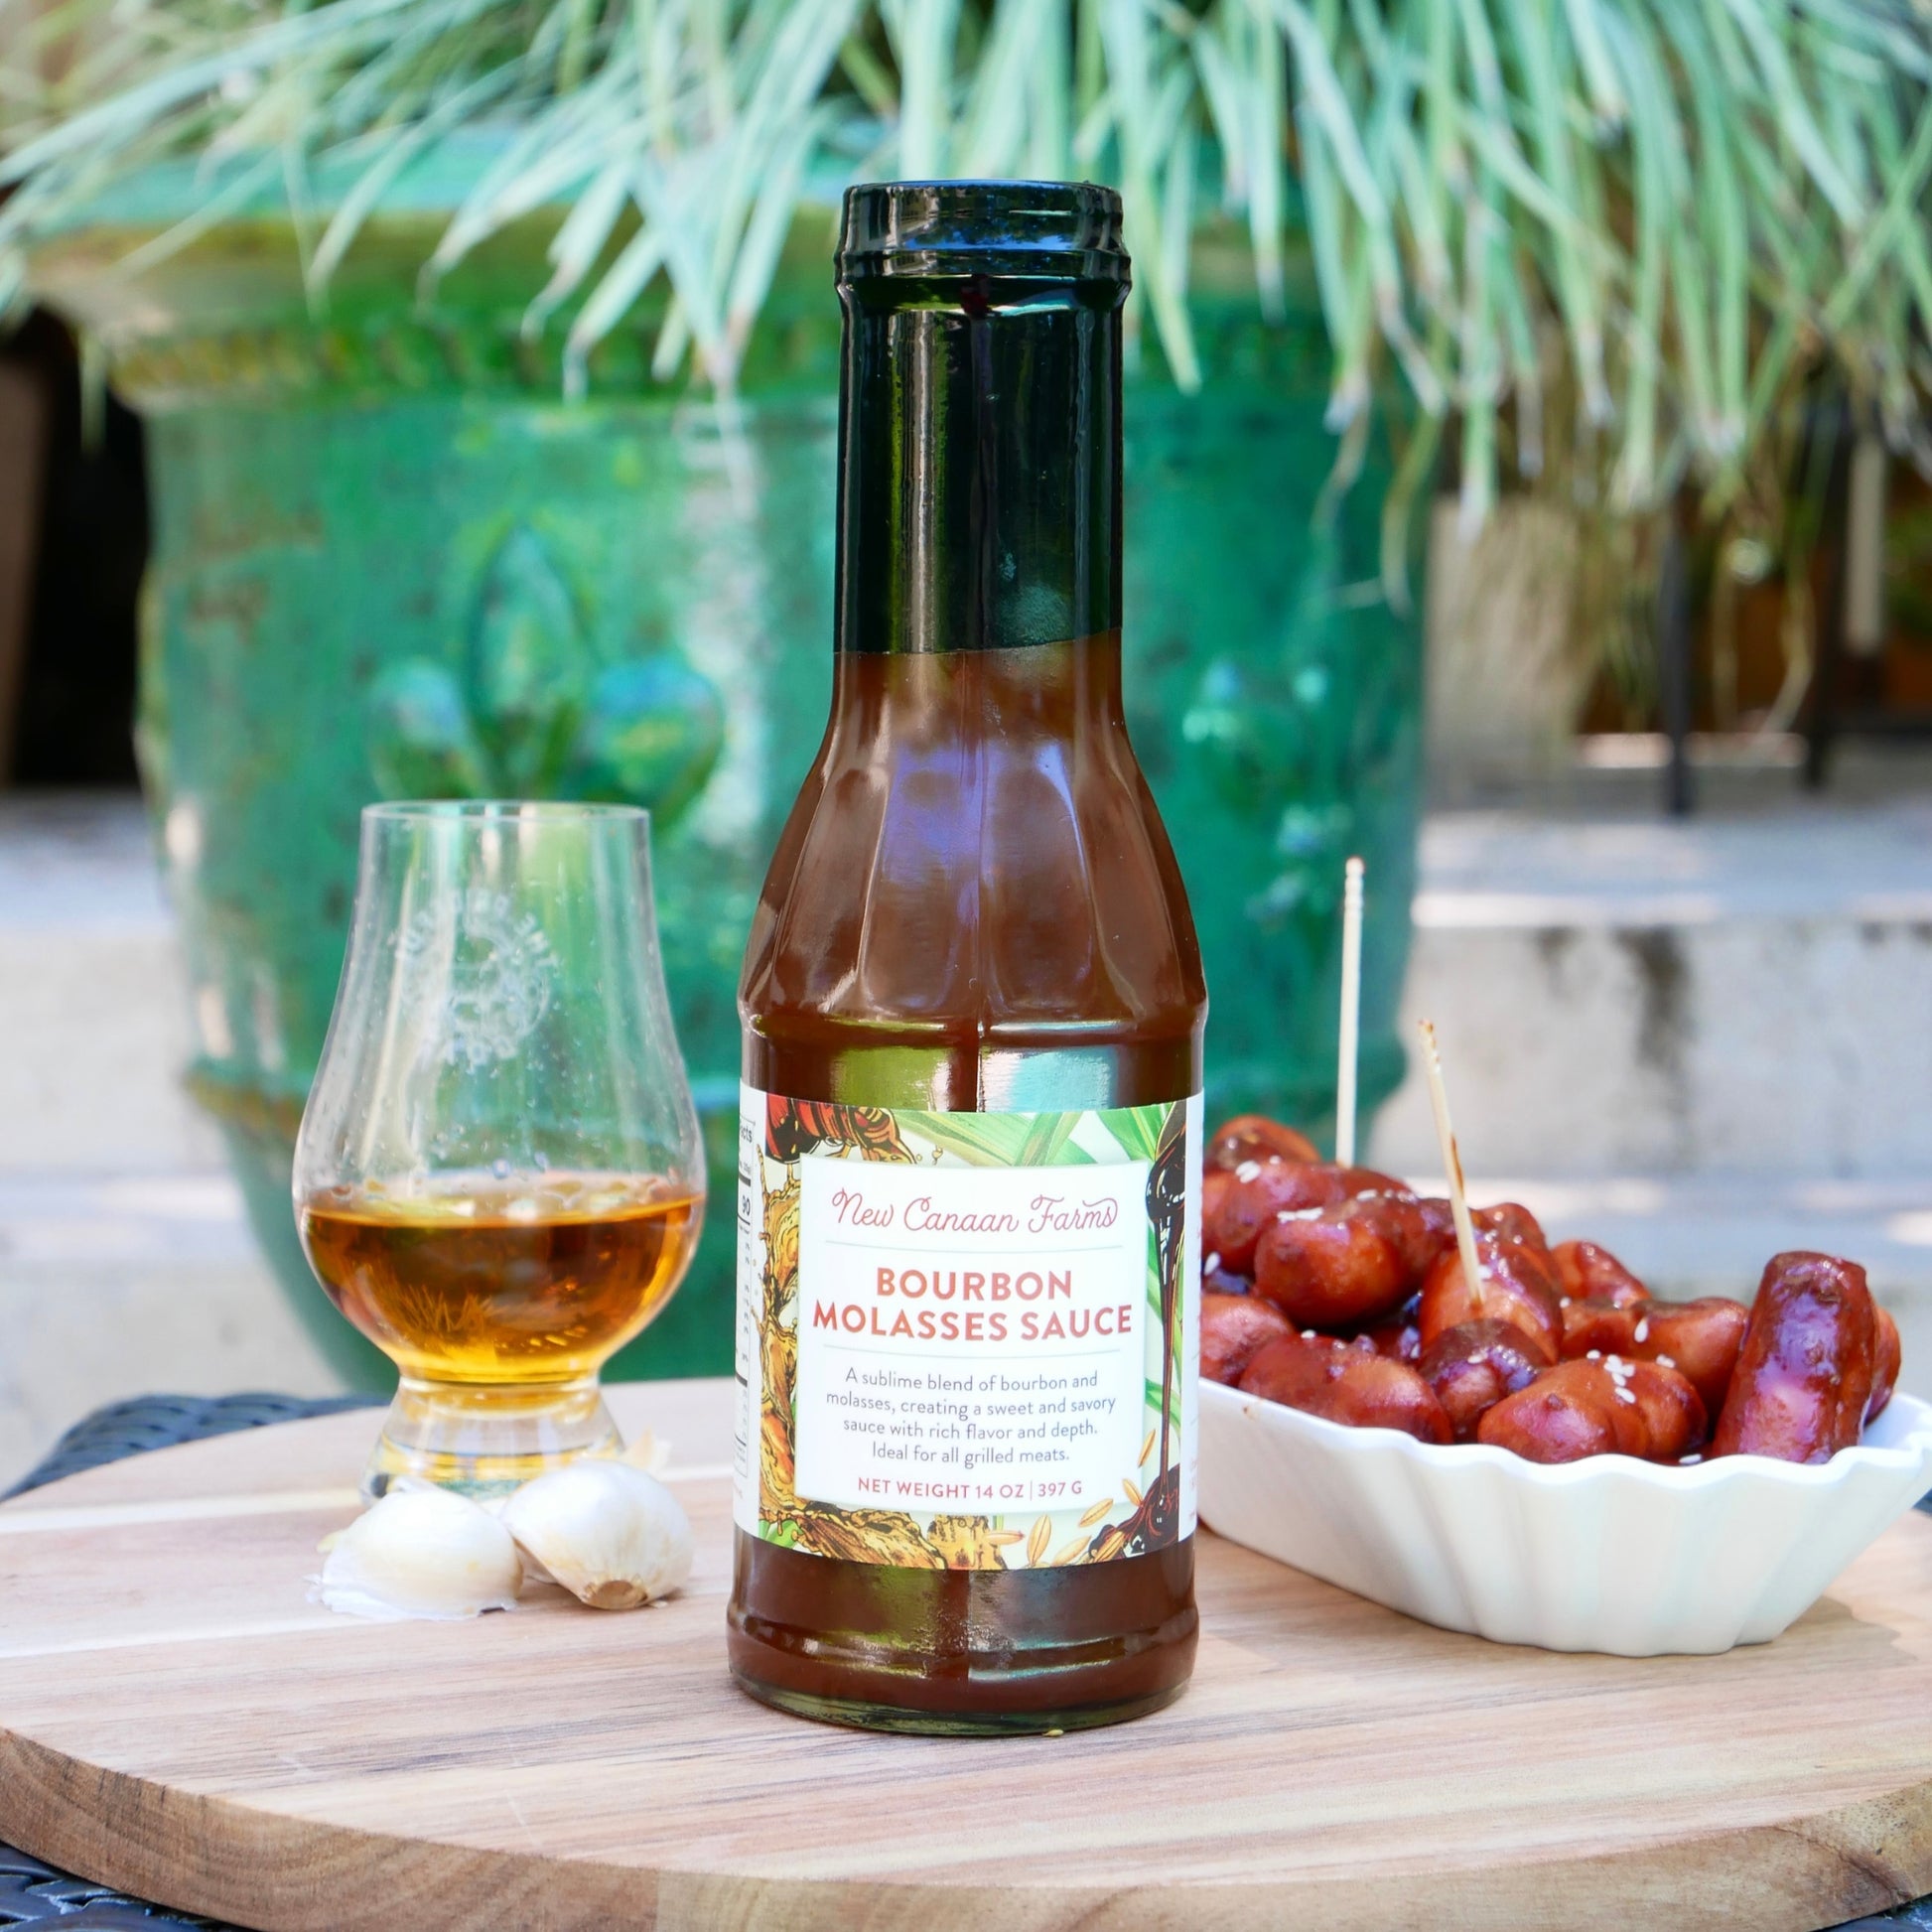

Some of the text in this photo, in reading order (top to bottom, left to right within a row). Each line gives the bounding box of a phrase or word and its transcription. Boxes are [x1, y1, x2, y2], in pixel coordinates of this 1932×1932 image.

[831, 1186, 1119, 1234] New Canaan Farms
[876, 1266, 1072, 1302] BOURBON
[812, 1299, 1133, 1343] MOLASSES SAUCE
[845, 1366, 1098, 1392] A sublime blend of bourbon and
[826, 1390, 1117, 1423] molasses, creating a sweet and savory
[843, 1418, 1098, 1443] sauce with rich flavor and depth.
[873, 1441, 1070, 1470] Ideal for all grilled meats.
[858, 1476, 1082, 1499] NET WEIGHT 14 OZ 397 G
